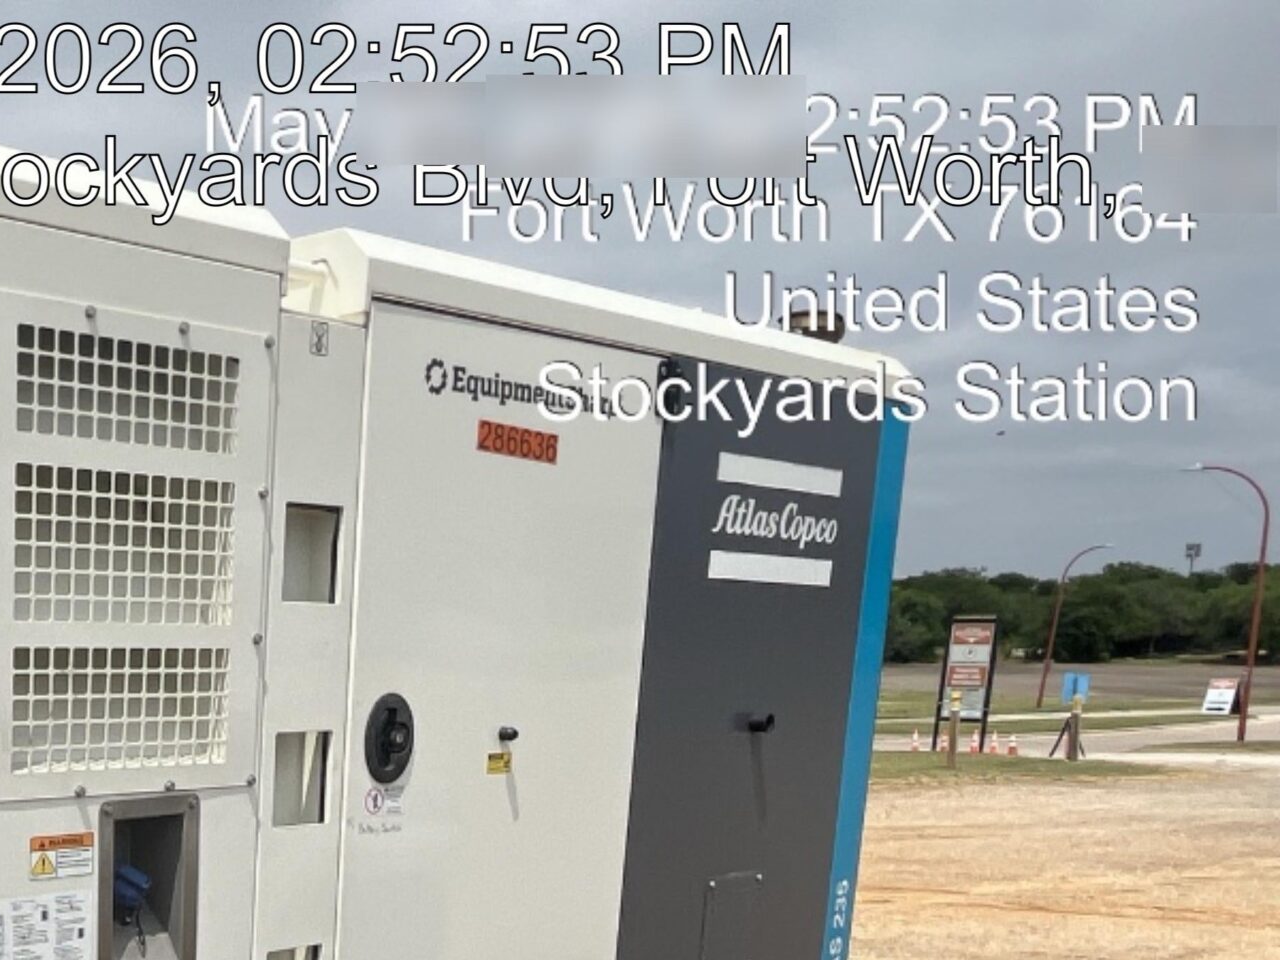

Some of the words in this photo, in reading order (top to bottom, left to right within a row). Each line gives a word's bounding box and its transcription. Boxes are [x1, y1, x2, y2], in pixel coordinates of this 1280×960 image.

[478, 421, 558, 463] 286636
[712, 494, 779, 539] Atlas
[780, 502, 838, 549] Copco
